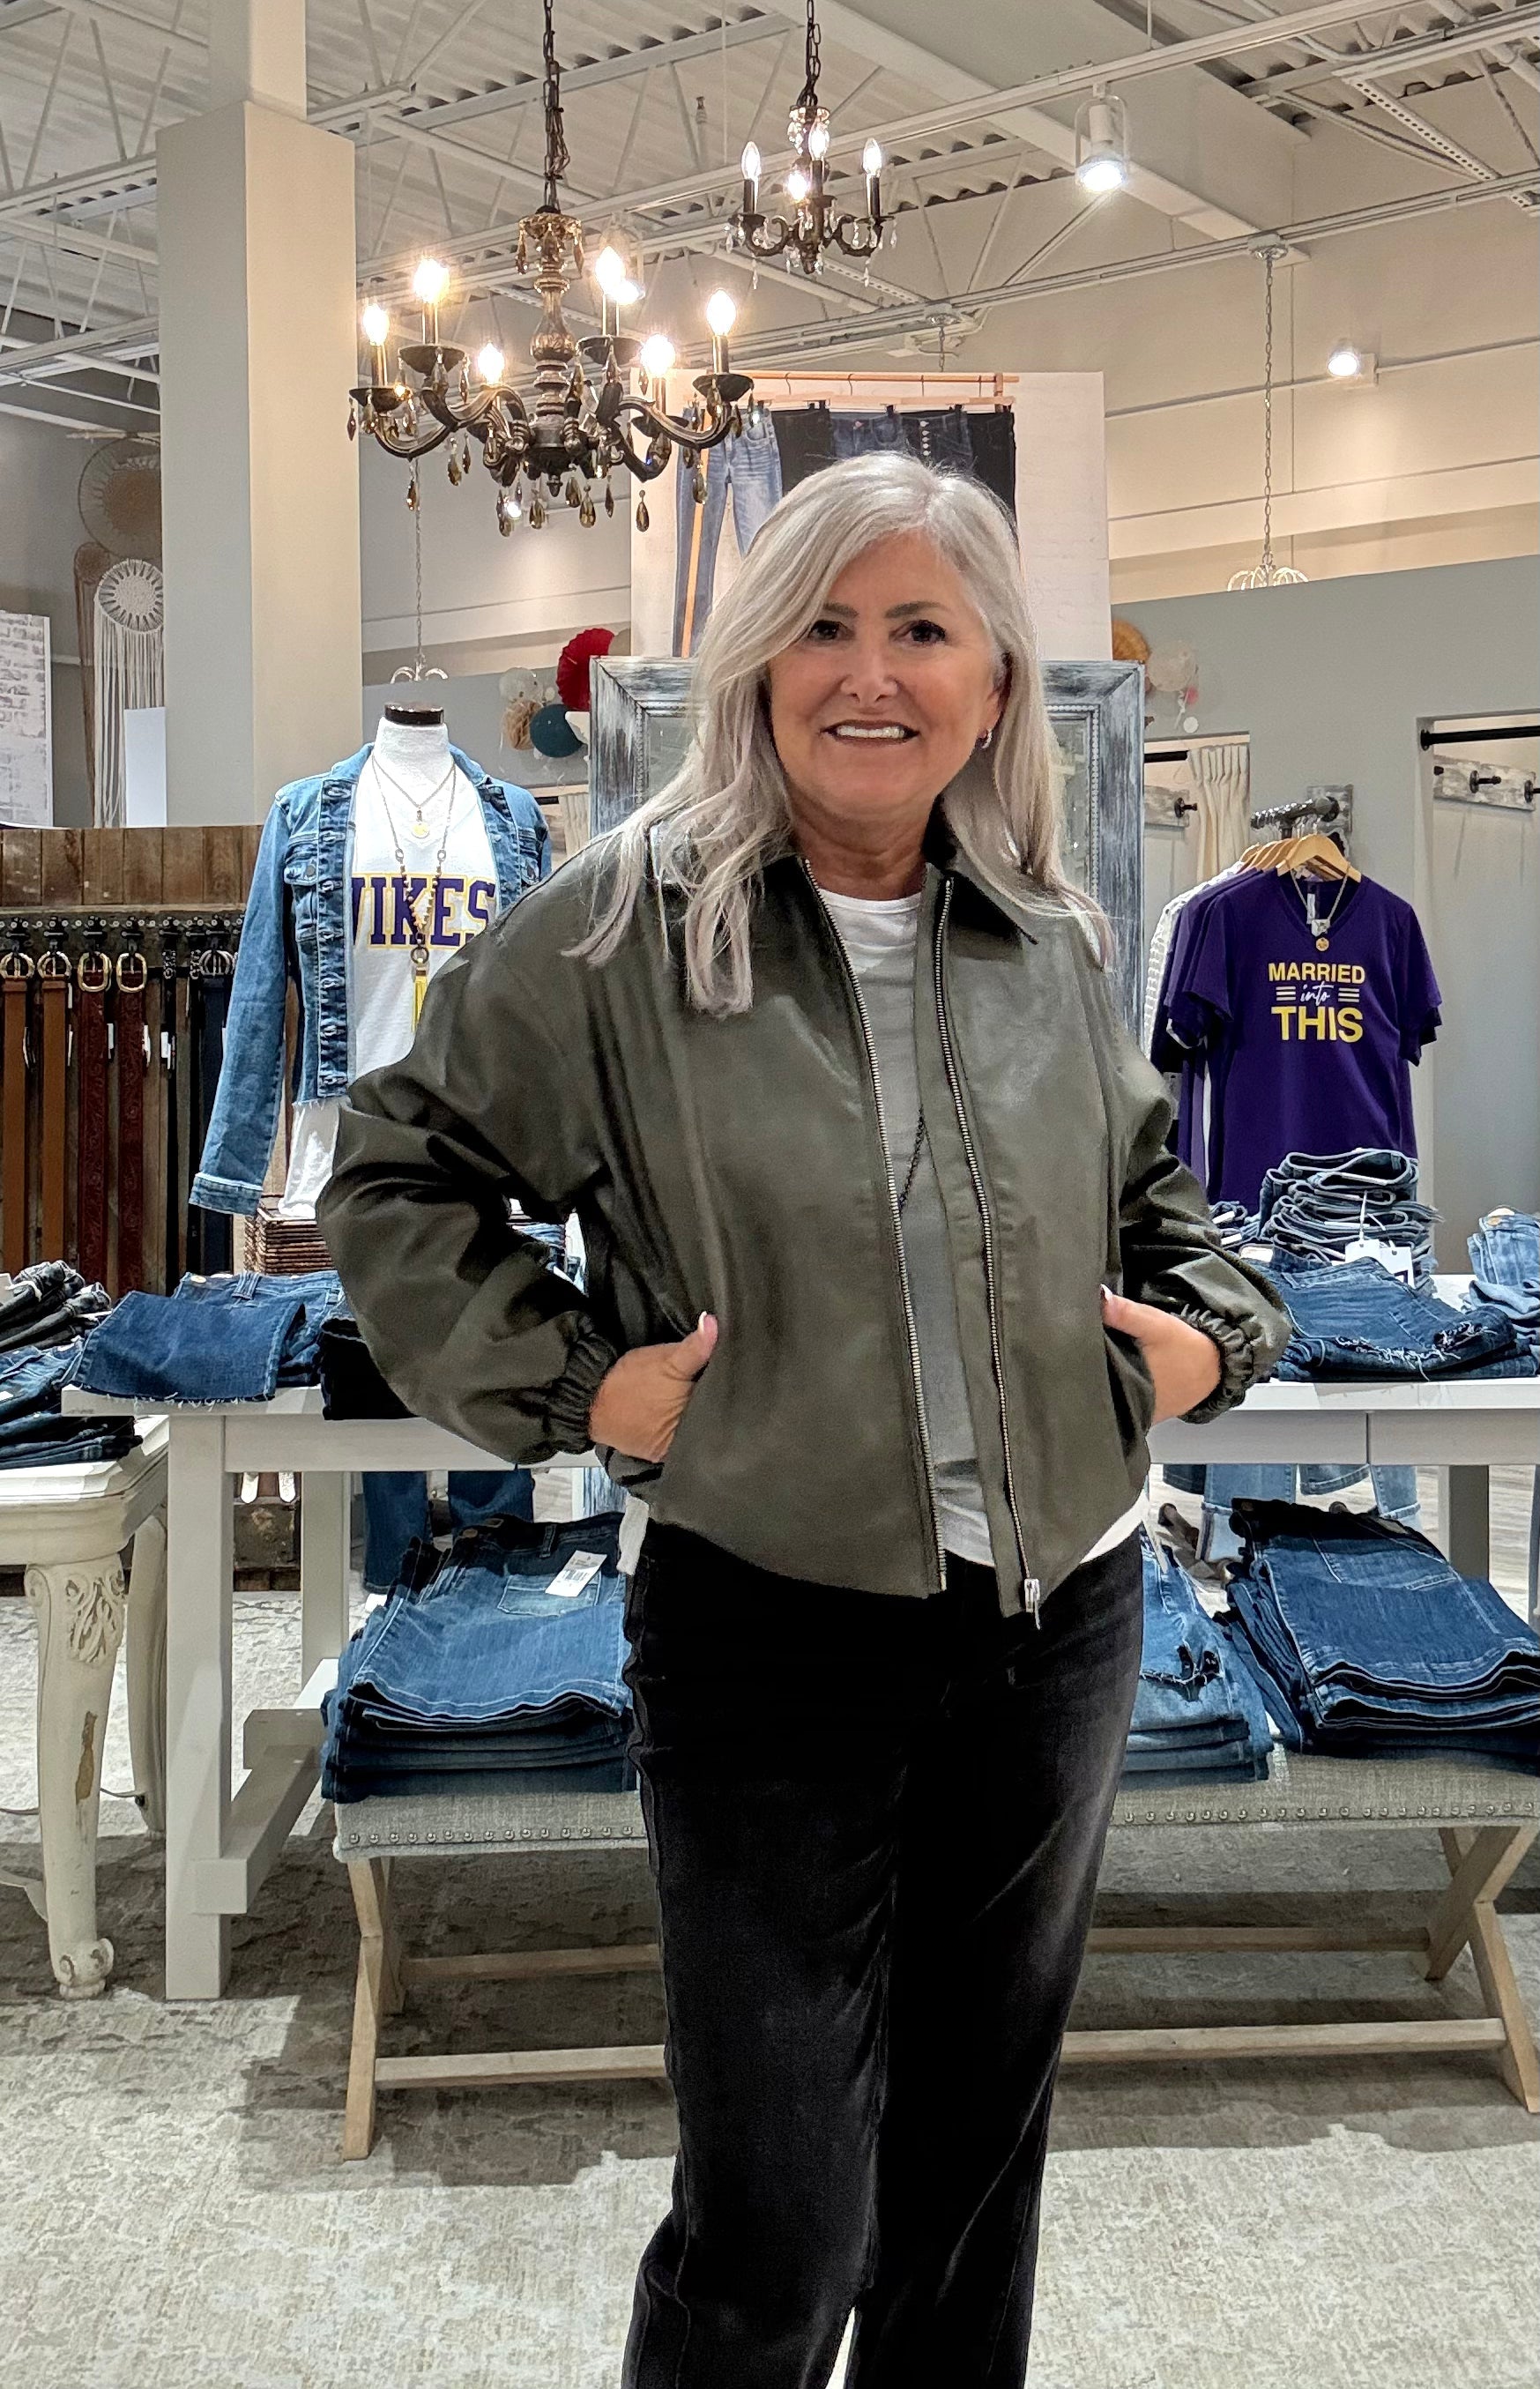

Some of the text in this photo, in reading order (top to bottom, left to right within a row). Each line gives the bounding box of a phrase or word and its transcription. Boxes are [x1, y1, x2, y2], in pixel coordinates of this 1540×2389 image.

[1268, 962, 1365, 984] MARRIED
[1300, 981, 1334, 1006] into
[1271, 1006, 1364, 1043] THIS
